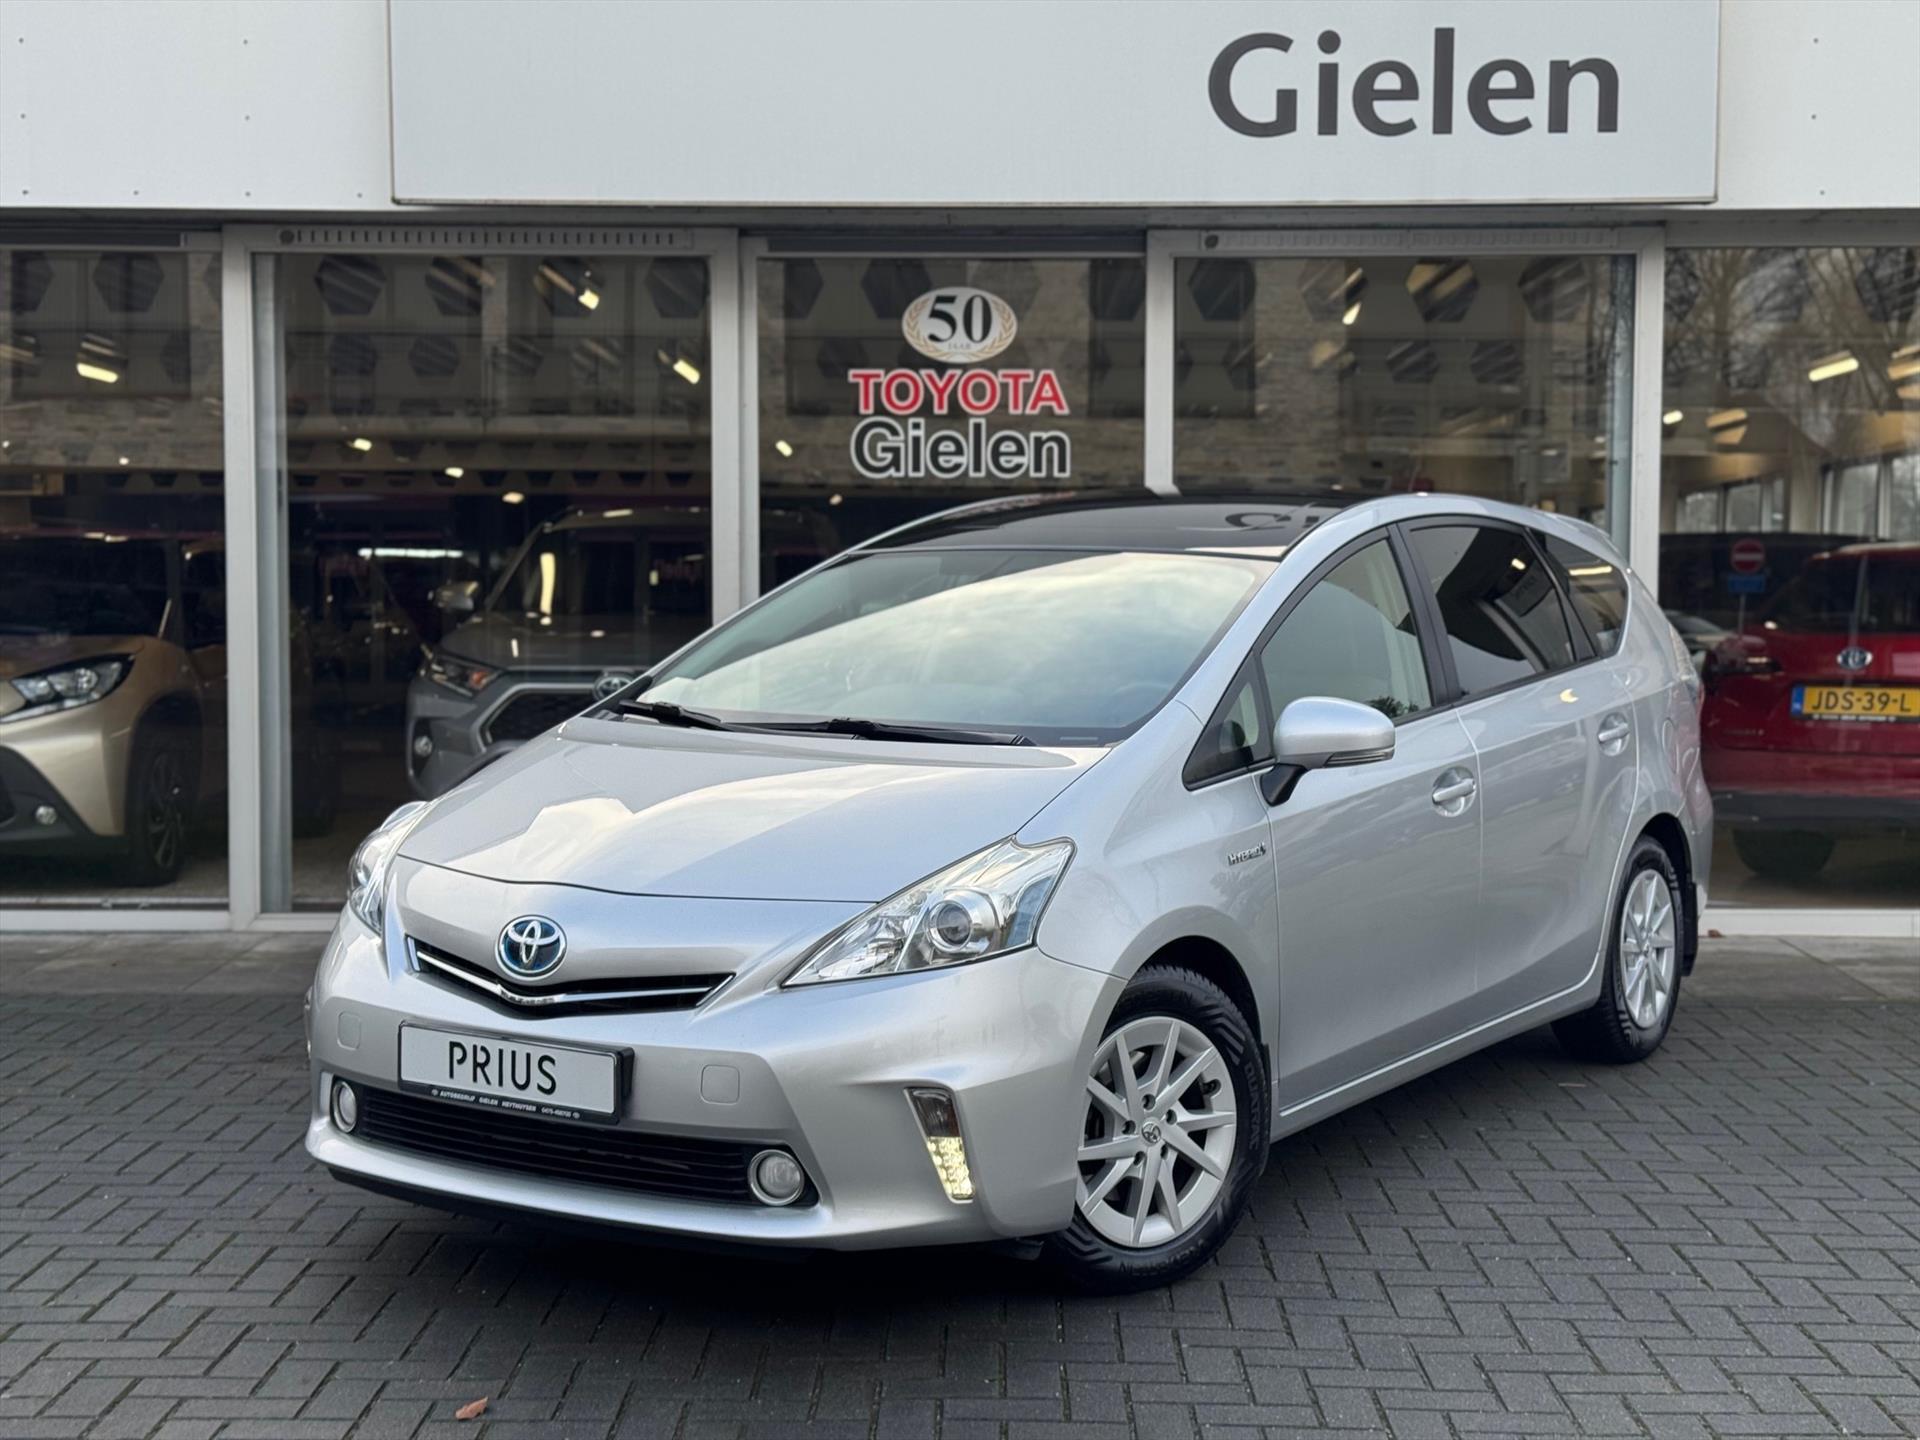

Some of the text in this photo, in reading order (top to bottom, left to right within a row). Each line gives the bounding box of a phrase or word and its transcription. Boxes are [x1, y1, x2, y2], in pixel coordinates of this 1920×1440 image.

[1208, 27, 1619, 138] Gielen
[927, 294, 993, 343] 50
[848, 369, 1070, 415] TOYOTA
[850, 415, 1071, 479] Gielen
[1812, 689, 1912, 712] JDS-39-L
[448, 1041, 557, 1096] PRIUS
[478, 1097, 499, 1106] GIELEN
[1244, 1061, 1261, 1151] QUATRAC
